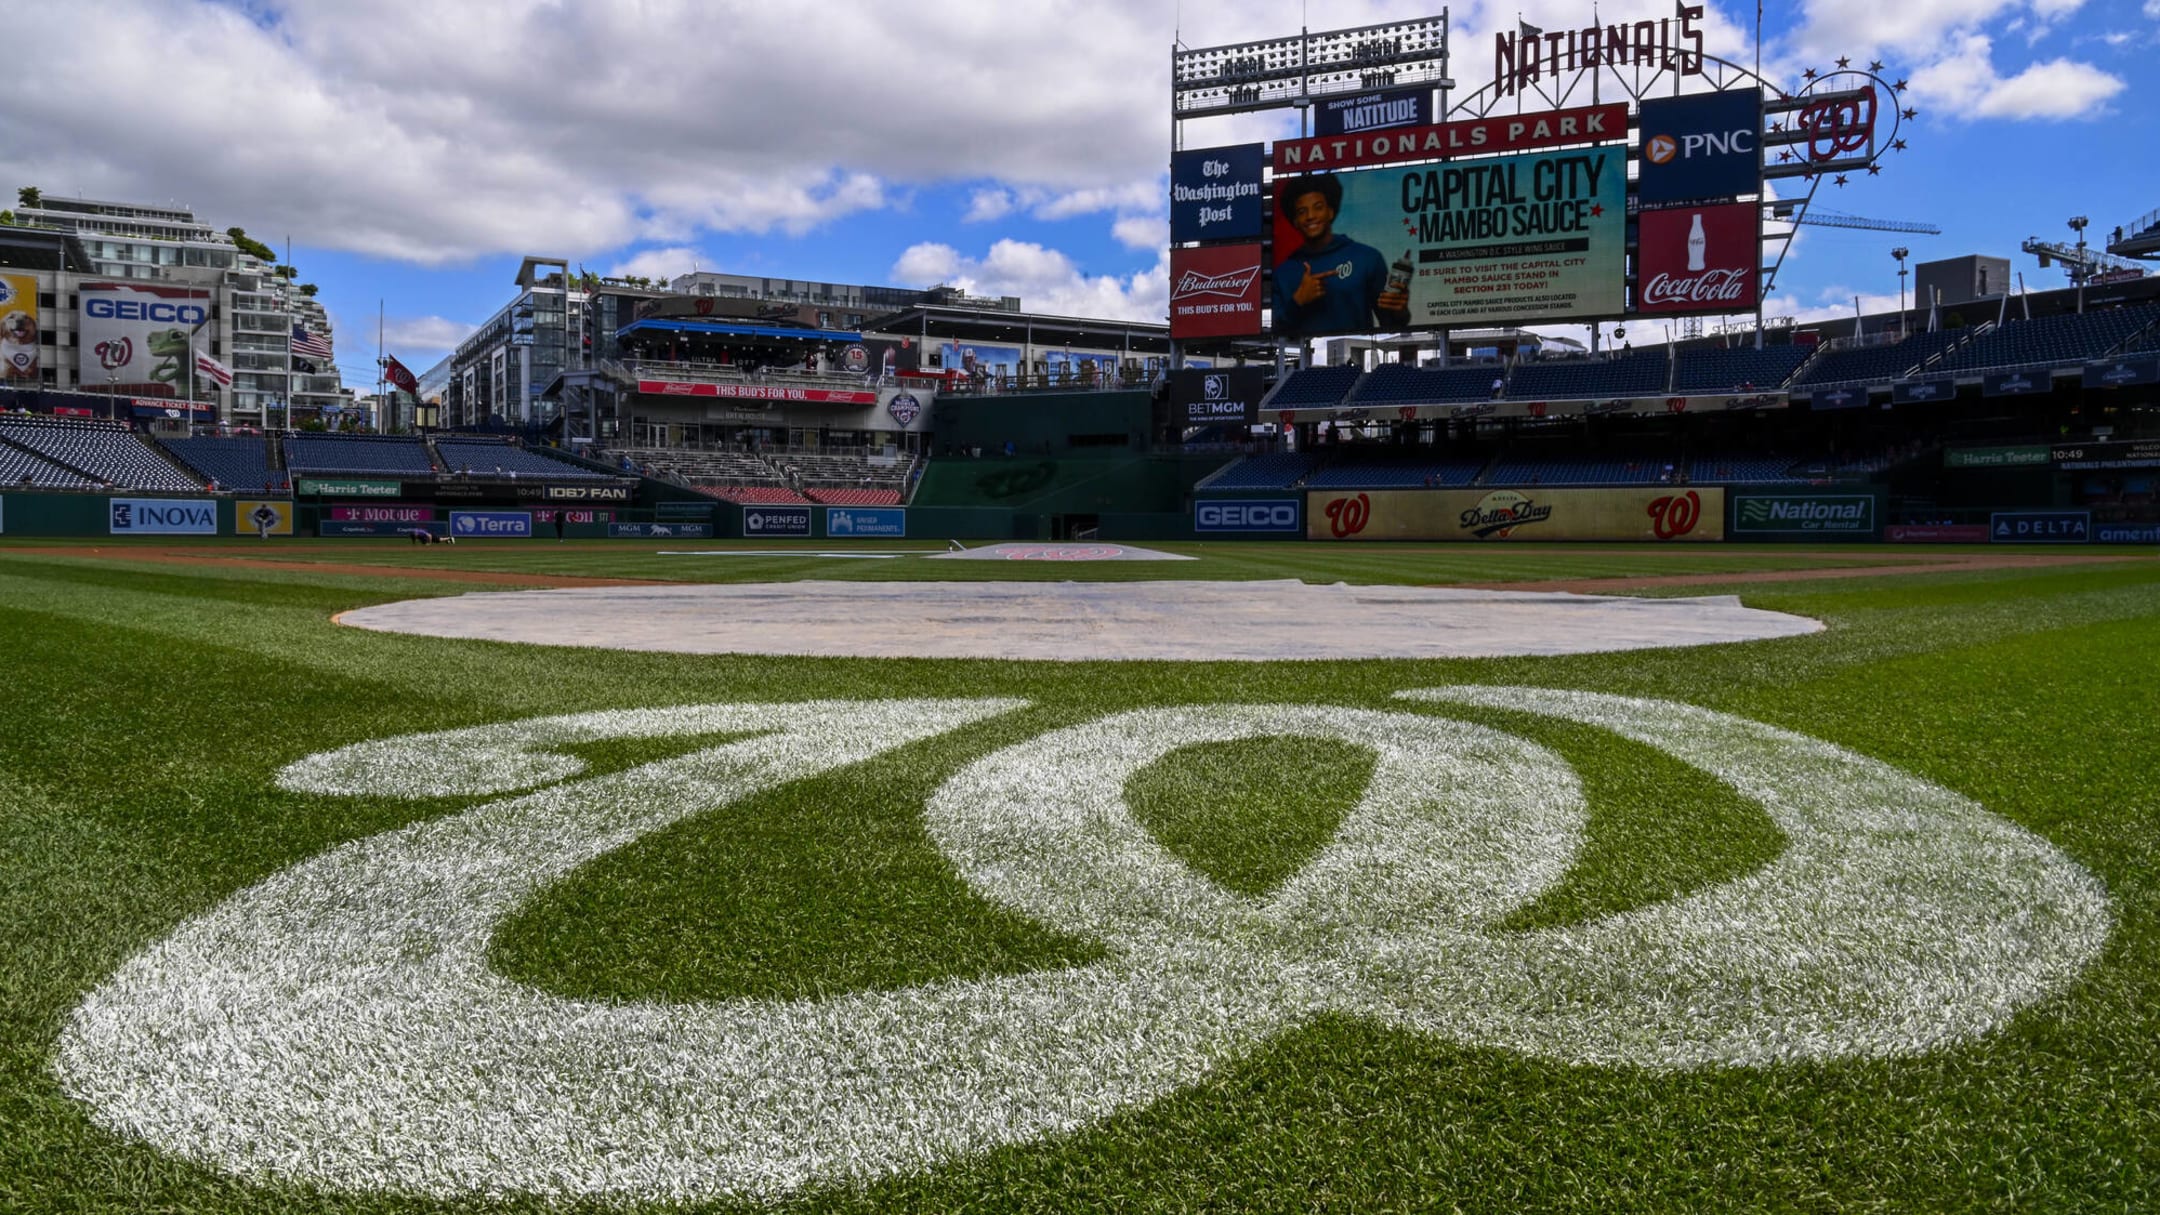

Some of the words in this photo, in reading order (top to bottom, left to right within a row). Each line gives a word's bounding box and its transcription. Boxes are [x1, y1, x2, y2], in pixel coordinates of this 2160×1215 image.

[1496, 5, 1704, 98] NATIONALS
[1328, 98, 1354, 109] SHOW
[1357, 94, 1382, 104] SOME
[1344, 97, 1418, 130] NATITUDE
[1284, 133, 1487, 165] NATIONALS
[1509, 113, 1605, 144] PARK
[1682, 129, 1753, 159] PNC
[1203, 160, 1229, 178] The
[1175, 181, 1259, 202] Washington
[1402, 163, 1526, 214] CAPITAL
[1534, 154, 1606, 202] CITY
[1199, 205, 1232, 228] Post
[1420, 207, 1508, 244] MAMBO
[1513, 200, 1589, 237] SAUCE
[1433, 267, 1456, 275] SURE
[1475, 264, 1497, 272] VISIT
[1501, 263, 1518, 271] THE
[1521, 260, 1560, 269] CAPITAL
[1564, 258, 1586, 266] CITY
[1178, 276, 1250, 292] Budweiser
[1444, 276, 1478, 284] MAMBO
[1481, 273, 1512, 282] SAUCE
[1515, 271, 1546, 280] STAND
[1549, 270, 1559, 278] IN
[1454, 285, 1493, 294] SECTION
[1495, 283, 1511, 292] 231
[1514, 281, 1548, 290] TODAY!
[1644, 268, 1750, 304] Coca-Cola
[1551, 293, 1576, 301] LOCATED
[86, 299, 205, 324] GEICO
[1178, 306, 1194, 315] THIS
[1196, 305, 1218, 314] BUD'S
[1220, 304, 1235, 312] FOR
[1237, 302, 1254, 311] YOU.
[851, 350, 863, 360] 15
[715, 385, 736, 396] THIS
[738, 387, 765, 397] BUD'S
[767, 388, 785, 398] FOR
[787, 389, 807, 400] YOU.
[135, 399, 163, 408] ADVANCE
[1188, 401, 1245, 415] BETMGM
[1963, 453, 2003, 465] Harris
[2005, 451, 2046, 463] Teeter
[2052, 450, 2083, 460] 10:49
[319, 483, 357, 494] Harris
[359, 484, 398, 495] Teeter
[591, 488, 627, 499] FAN
[139, 507, 215, 526] INOVA
[1199, 506, 1296, 526] GEICO
[1511, 499, 1553, 522] Day
[1769, 501, 1865, 520] National
[477, 517, 525, 531] Terra
[766, 515, 807, 525] PENFED
[1802, 520, 1821, 530] Car
[1824, 520, 1860, 530] Rental
[2017, 520, 2086, 534] DELTA
[618, 524, 641, 532] MGM
[681, 524, 703, 532] MGM
